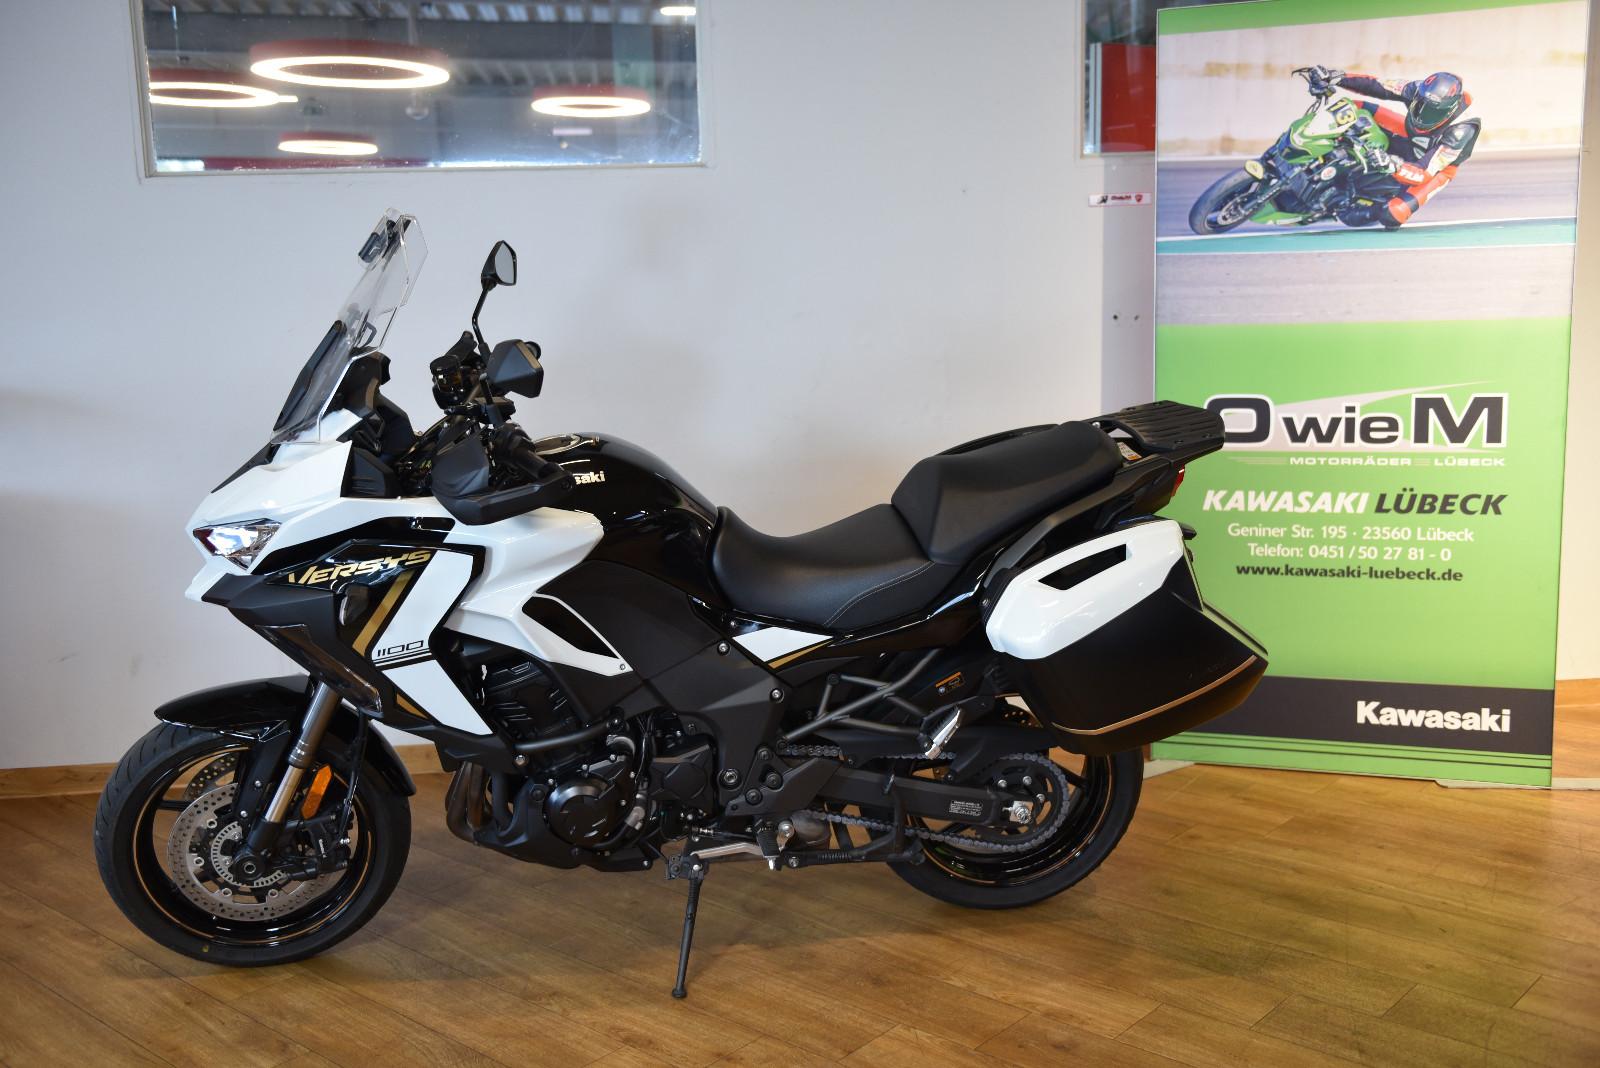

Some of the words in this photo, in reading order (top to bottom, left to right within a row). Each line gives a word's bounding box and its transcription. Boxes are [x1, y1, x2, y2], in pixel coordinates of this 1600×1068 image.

[1204, 395, 1273, 446] O
[1281, 404, 1400, 445] wie
[1412, 395, 1506, 446] M
[1289, 456, 1411, 466] MOTORRÄDER
[1434, 456, 1505, 467] LÜBECK
[574, 470, 606, 485] saki
[1202, 490, 1370, 514] KAWASAKI
[1374, 487, 1508, 515] LÜBECK
[1227, 523, 1287, 537] Geniner
[1291, 524, 1314, 538] Str.
[1321, 525, 1347, 539] 195
[1362, 526, 1412, 540] 23560
[1416, 527, 1474, 542] Lübeck
[1248, 543, 1304, 557] Telefon:
[1308, 545, 1344, 558] 0451
[1383, 546, 1402, 560] 27
[1408, 547, 1424, 561] 81
[1440, 548, 1452, 561] 0
[288, 550, 432, 585] VERSYS
[1236, 564, 1464, 581] www.kawasaki-luebeck.de
[377, 640, 425, 657] 1100
[1356, 700, 1511, 732] Kawasaki
